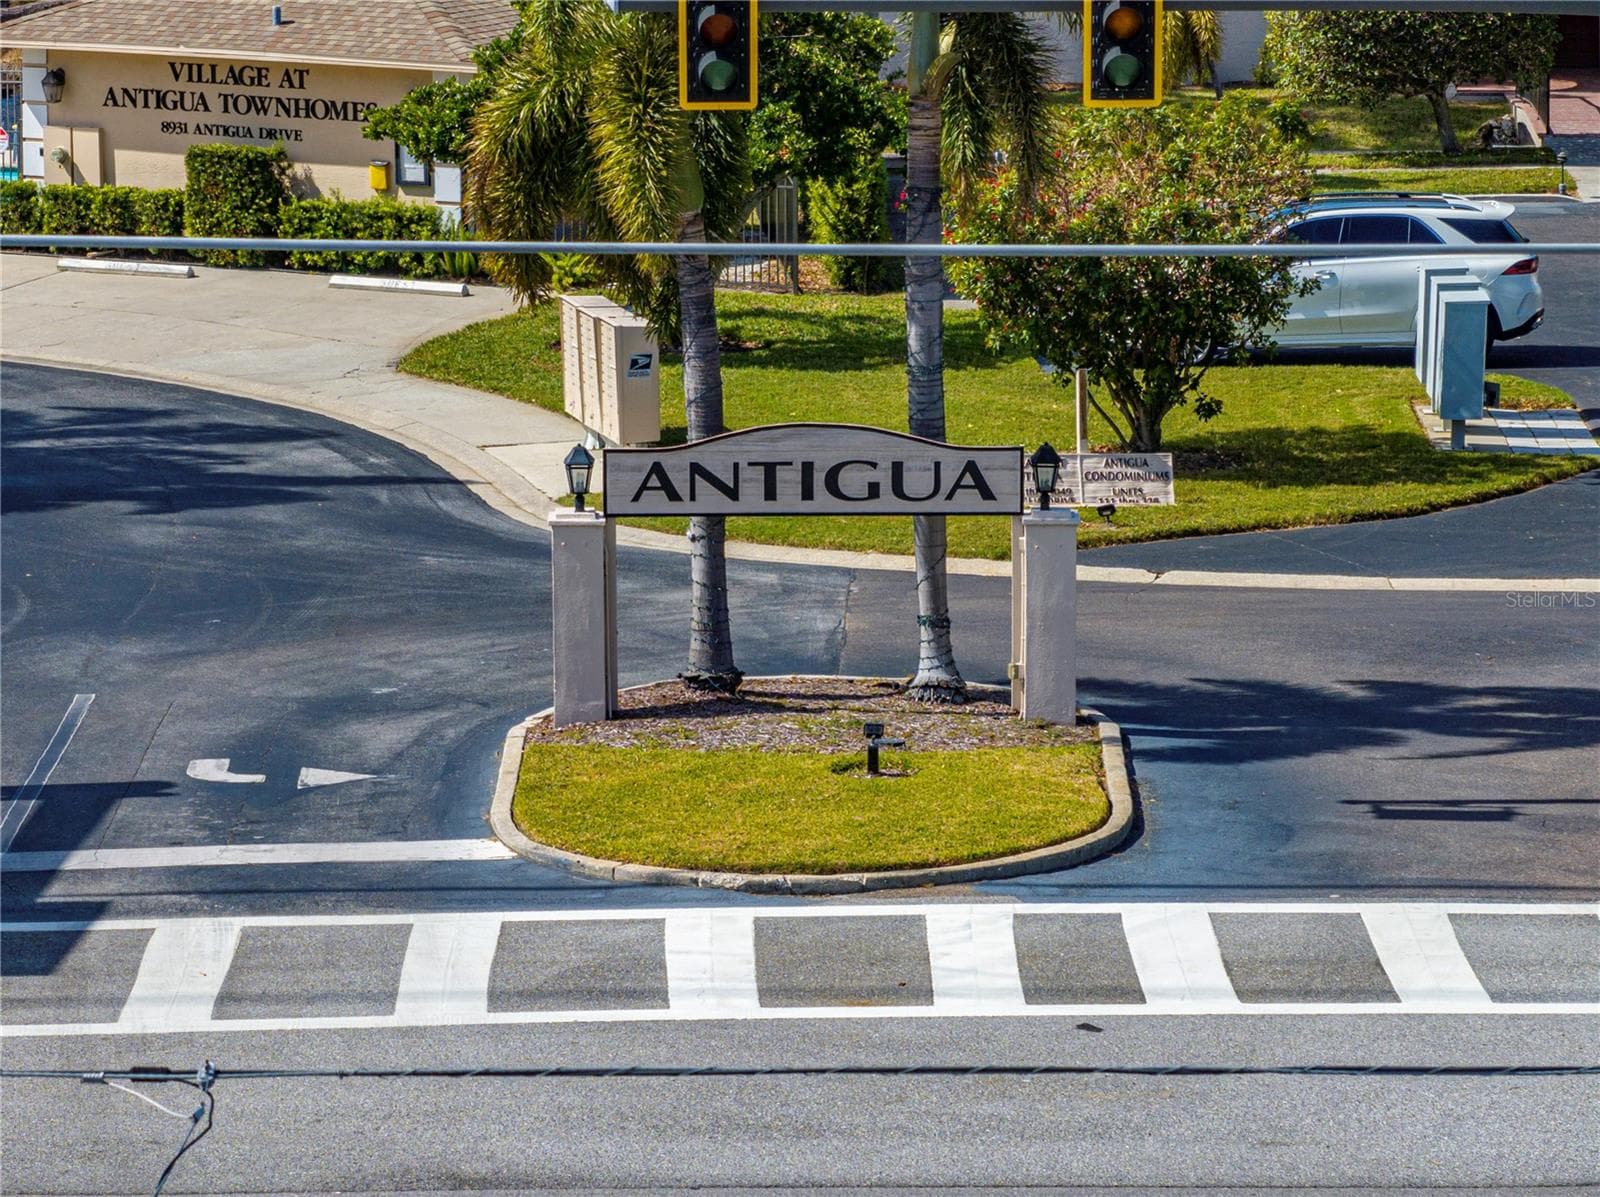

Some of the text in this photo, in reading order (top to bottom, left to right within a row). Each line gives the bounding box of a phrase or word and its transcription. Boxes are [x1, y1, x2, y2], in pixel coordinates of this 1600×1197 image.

[168, 61, 310, 90] VILLAGE AT
[102, 86, 212, 113] ANTIGUA
[161, 120, 303, 142] 8931 ANTIGUA DRIVE
[1103, 457, 1149, 468] ANTIGUA
[630, 459, 998, 502] ANTIGUA
[1084, 471, 1170, 481] CONDOMINIUMS
[1112, 487, 1144, 497] UNITS
